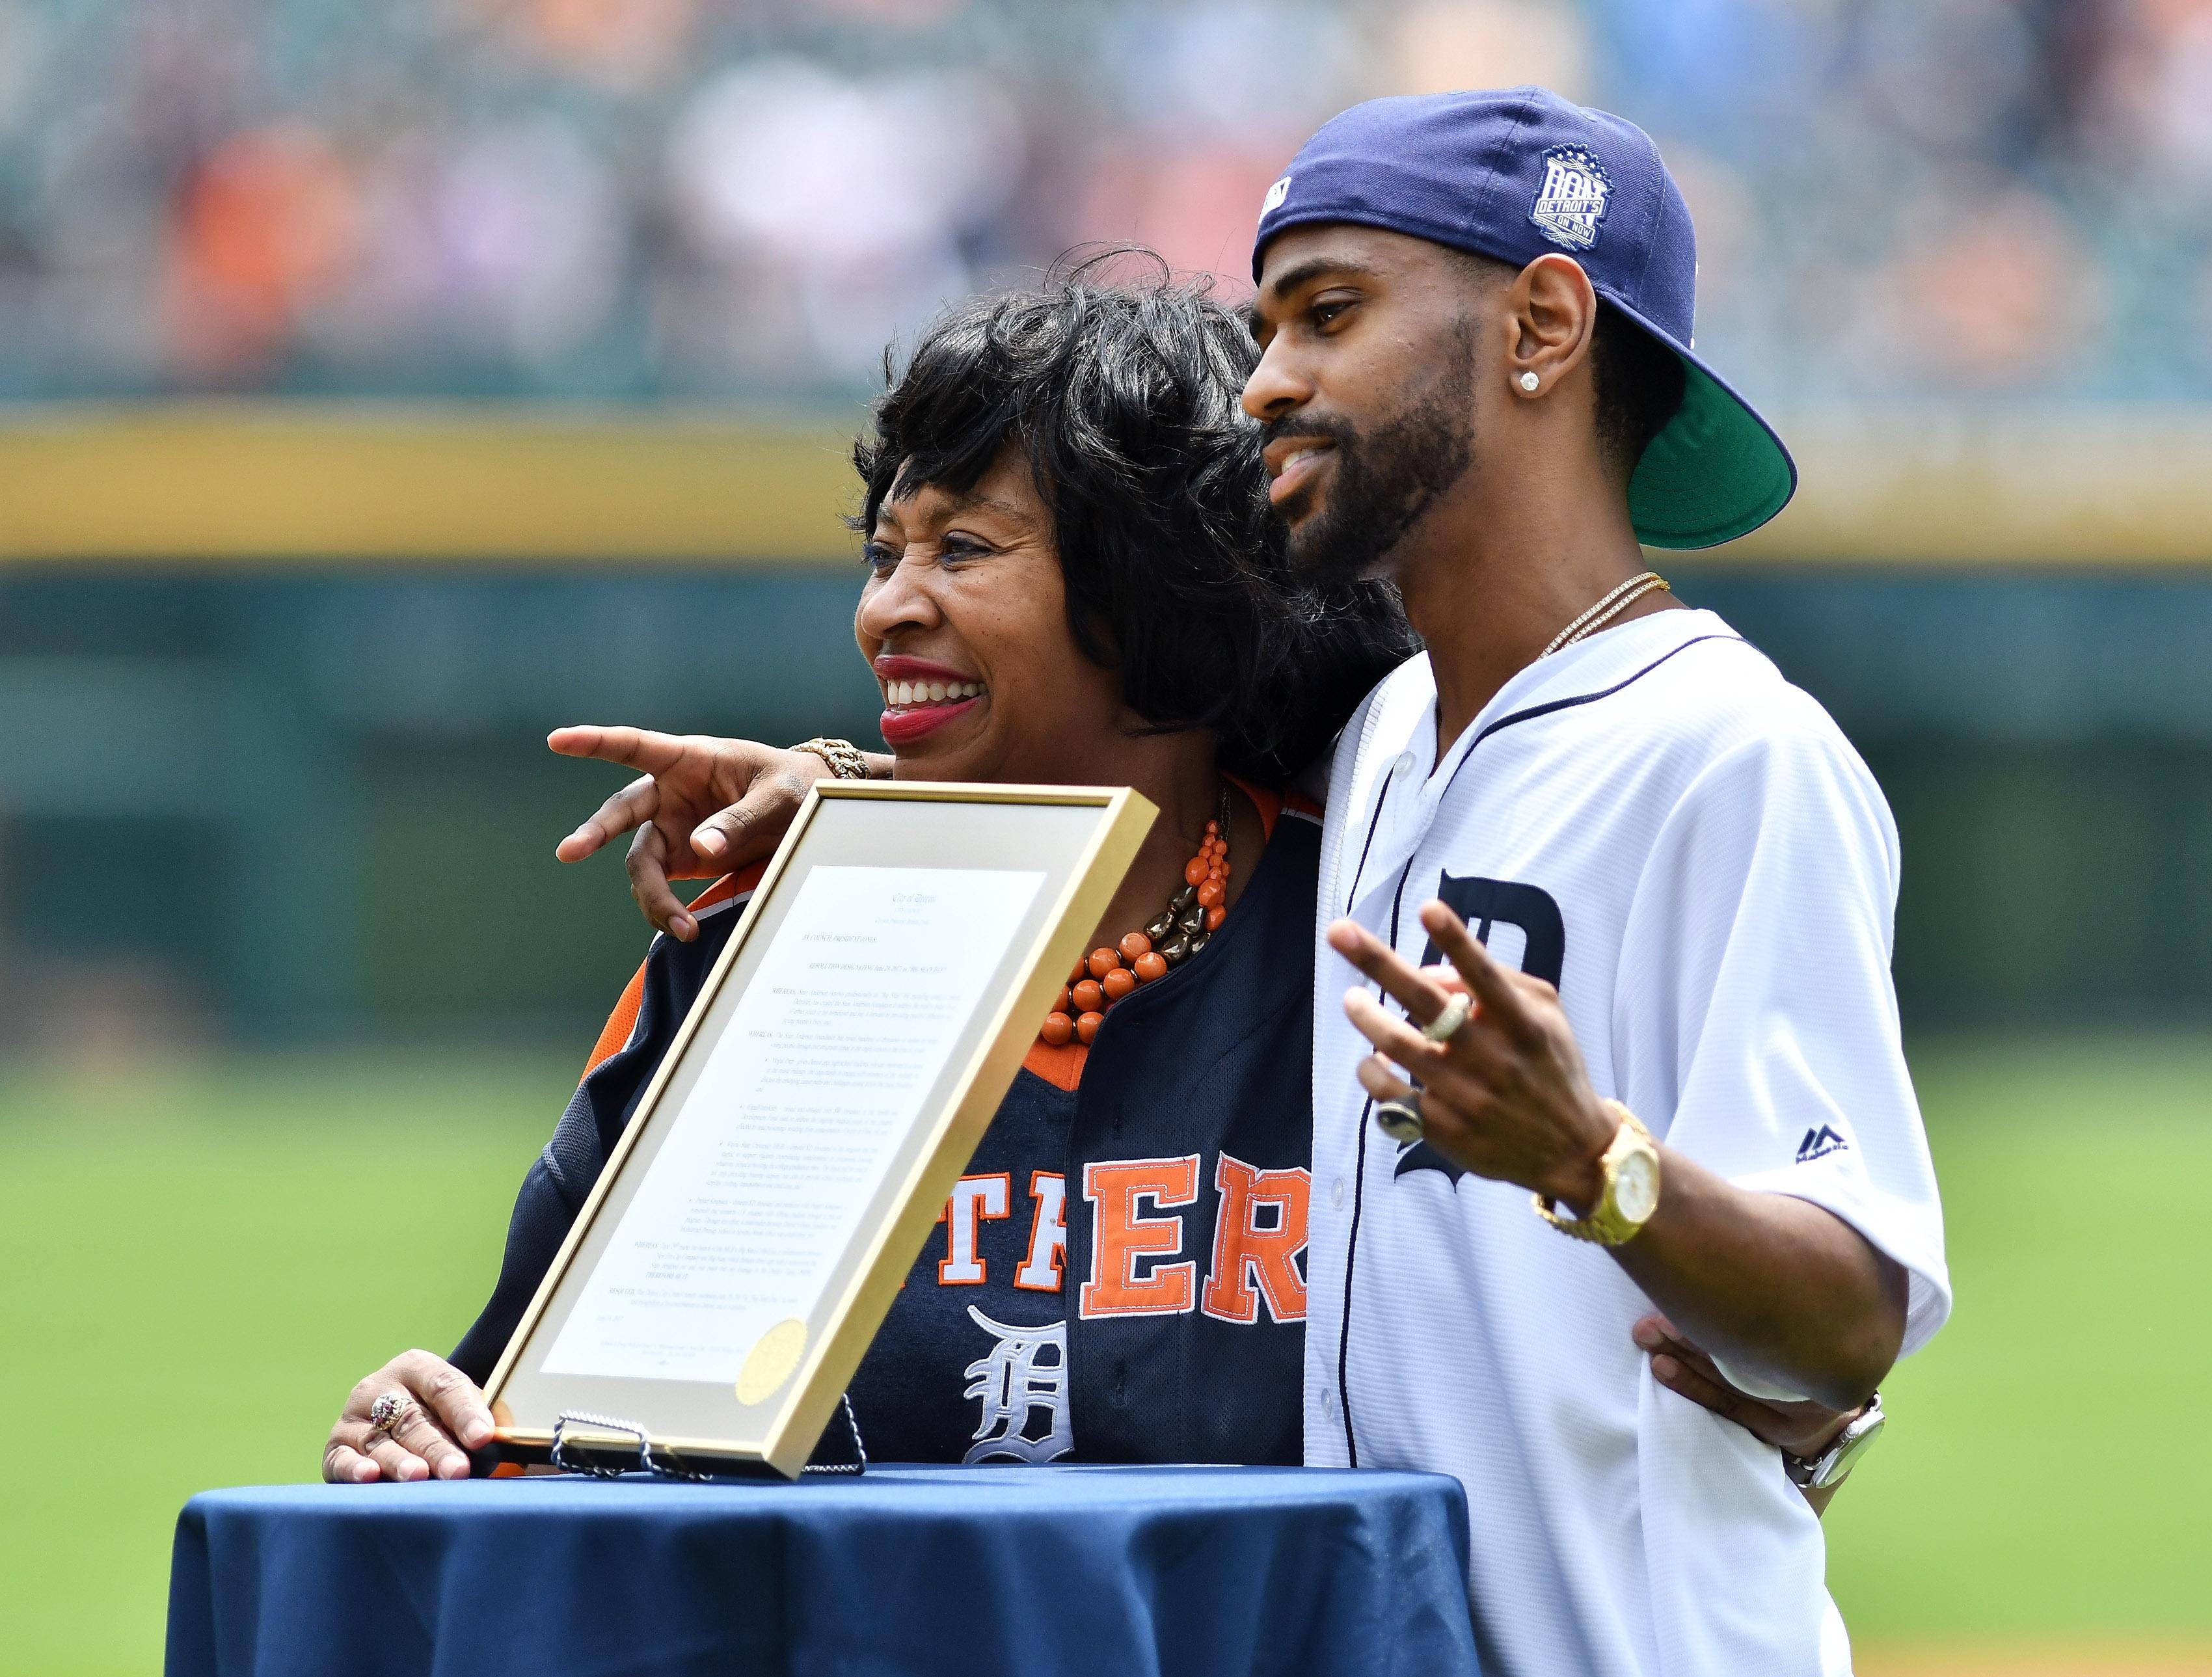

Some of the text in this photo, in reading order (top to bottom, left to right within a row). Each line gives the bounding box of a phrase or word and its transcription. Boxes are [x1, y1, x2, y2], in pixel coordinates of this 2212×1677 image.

[1538, 200, 1599, 213] DETROIT'S
[1558, 215, 1591, 238] ON NOW
